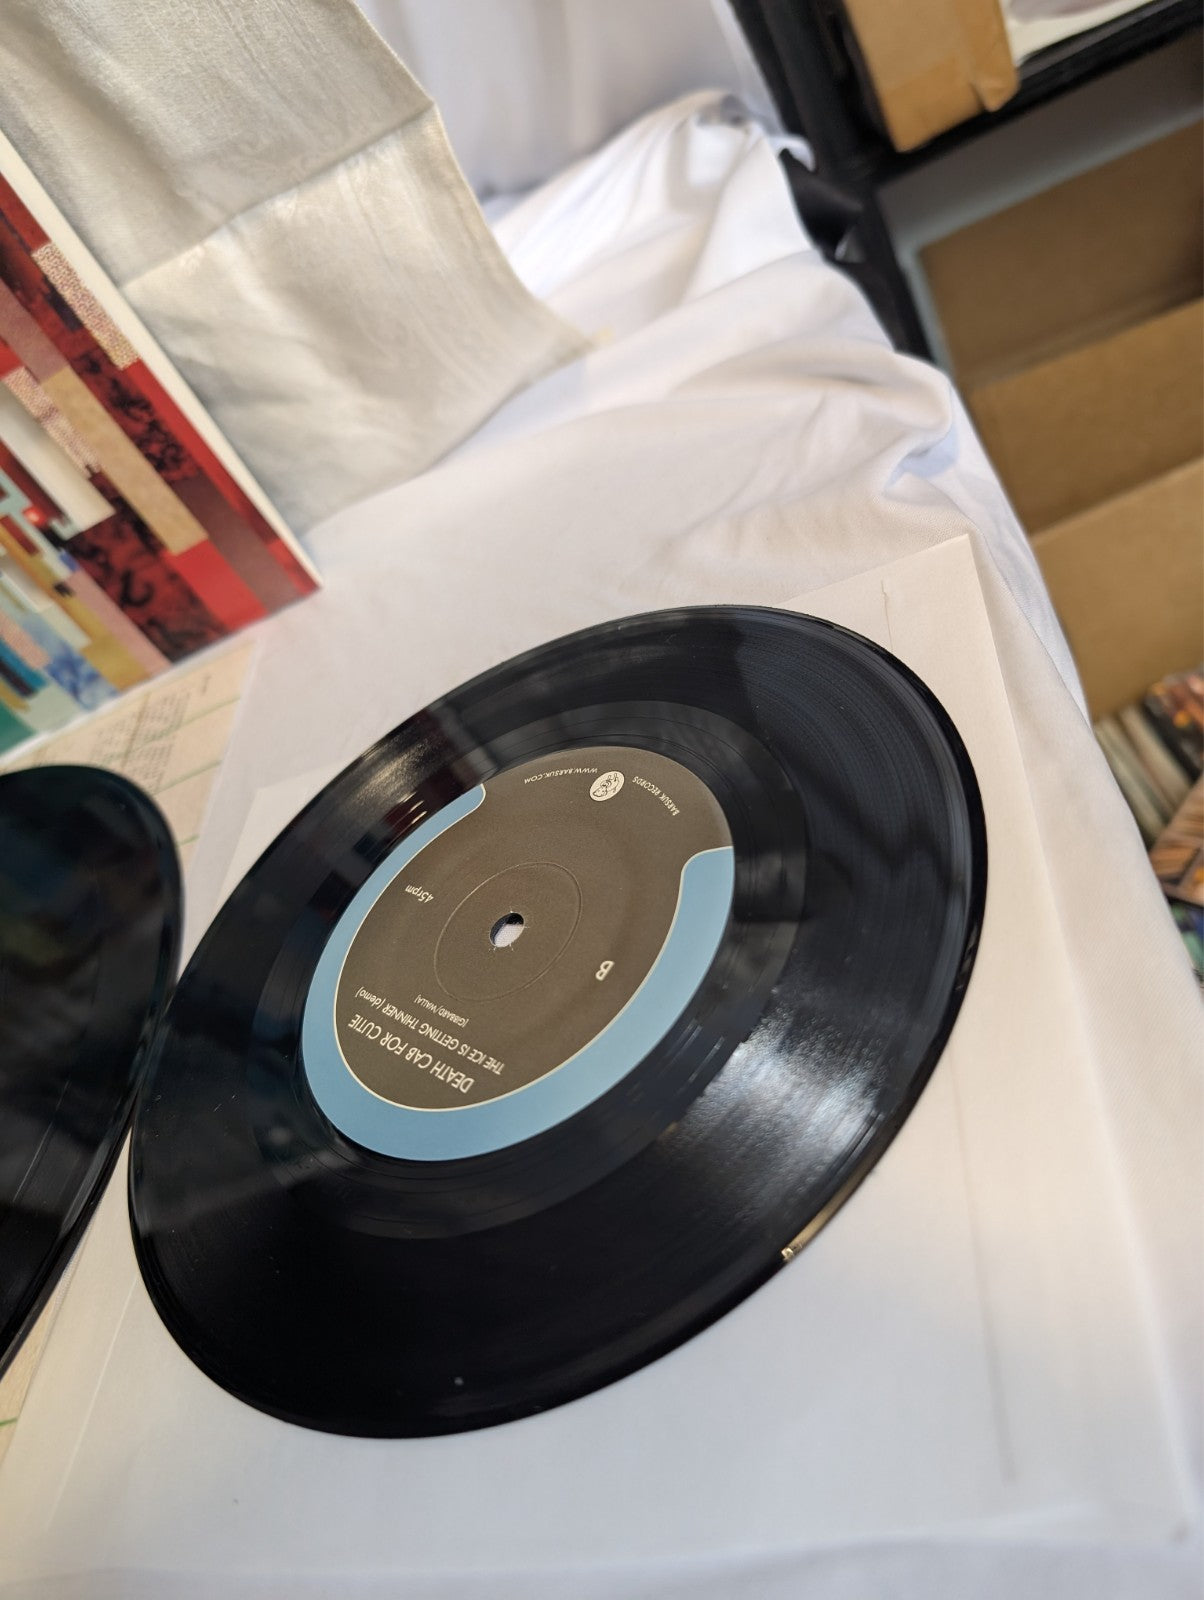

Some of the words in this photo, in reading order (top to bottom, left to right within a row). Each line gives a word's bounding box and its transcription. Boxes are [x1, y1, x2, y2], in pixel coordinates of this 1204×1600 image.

[524, 767, 598, 785] WWW.BARSUK.COM
[632, 775, 662, 796] RECORDS
[659, 792, 681, 816] BARSUK
[405, 885, 434, 903] 45rpm
[595, 960, 615, 981] B
[348, 1014, 382, 1040] CUTIE
[382, 1003, 420, 1030] THINNER
[379, 1031, 408, 1055] FOR
[418, 1022, 459, 1051] GETTING
[404, 1049, 433, 1069] CAB
[457, 1043, 469, 1056] IS
[467, 1049, 487, 1065] ICE
[429, 1060, 475, 1093] DEATH
[483, 1056, 505, 1076] THE
